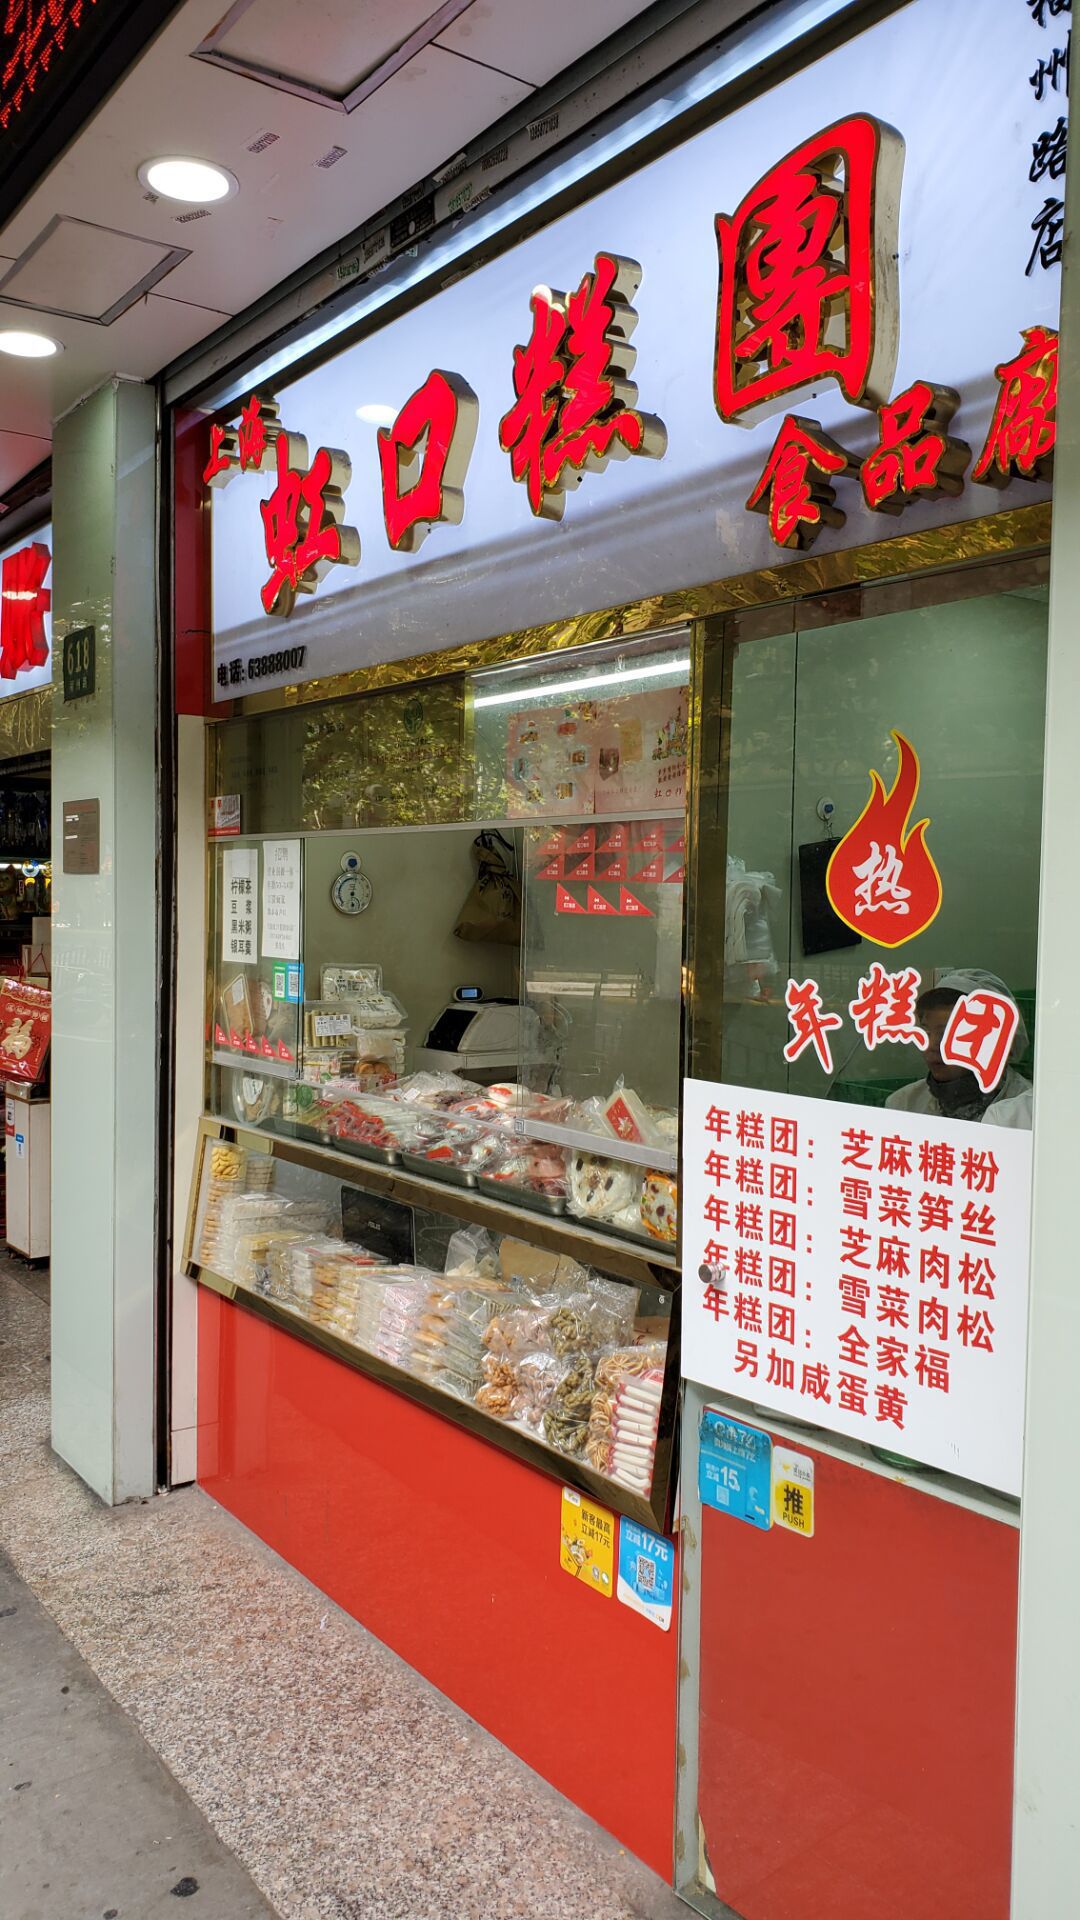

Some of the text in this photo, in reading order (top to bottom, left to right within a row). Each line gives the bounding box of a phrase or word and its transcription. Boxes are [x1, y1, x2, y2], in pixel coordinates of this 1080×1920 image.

[203, 395, 272, 485] 上海
[67, 637, 89, 675] 618
[852, 841, 911, 916] 热
[783, 962, 1019, 1093] 年糕团
[841, 1127, 1000, 1193] 芝麻糖粉
[840, 1176, 997, 1247] 雪菜笋丝
[839, 1225, 997, 1300] 芝麻肉松
[838, 1273, 996, 1353] 雪菜肉松
[734, 1338, 908, 1430] 另加咸蛋黄
[837, 1324, 950, 1393] 全家福
[581, 1522, 611, 1549] 立减17元
[782, 1511, 805, 1528] PUSH
[784, 1484, 804, 1516] 推
